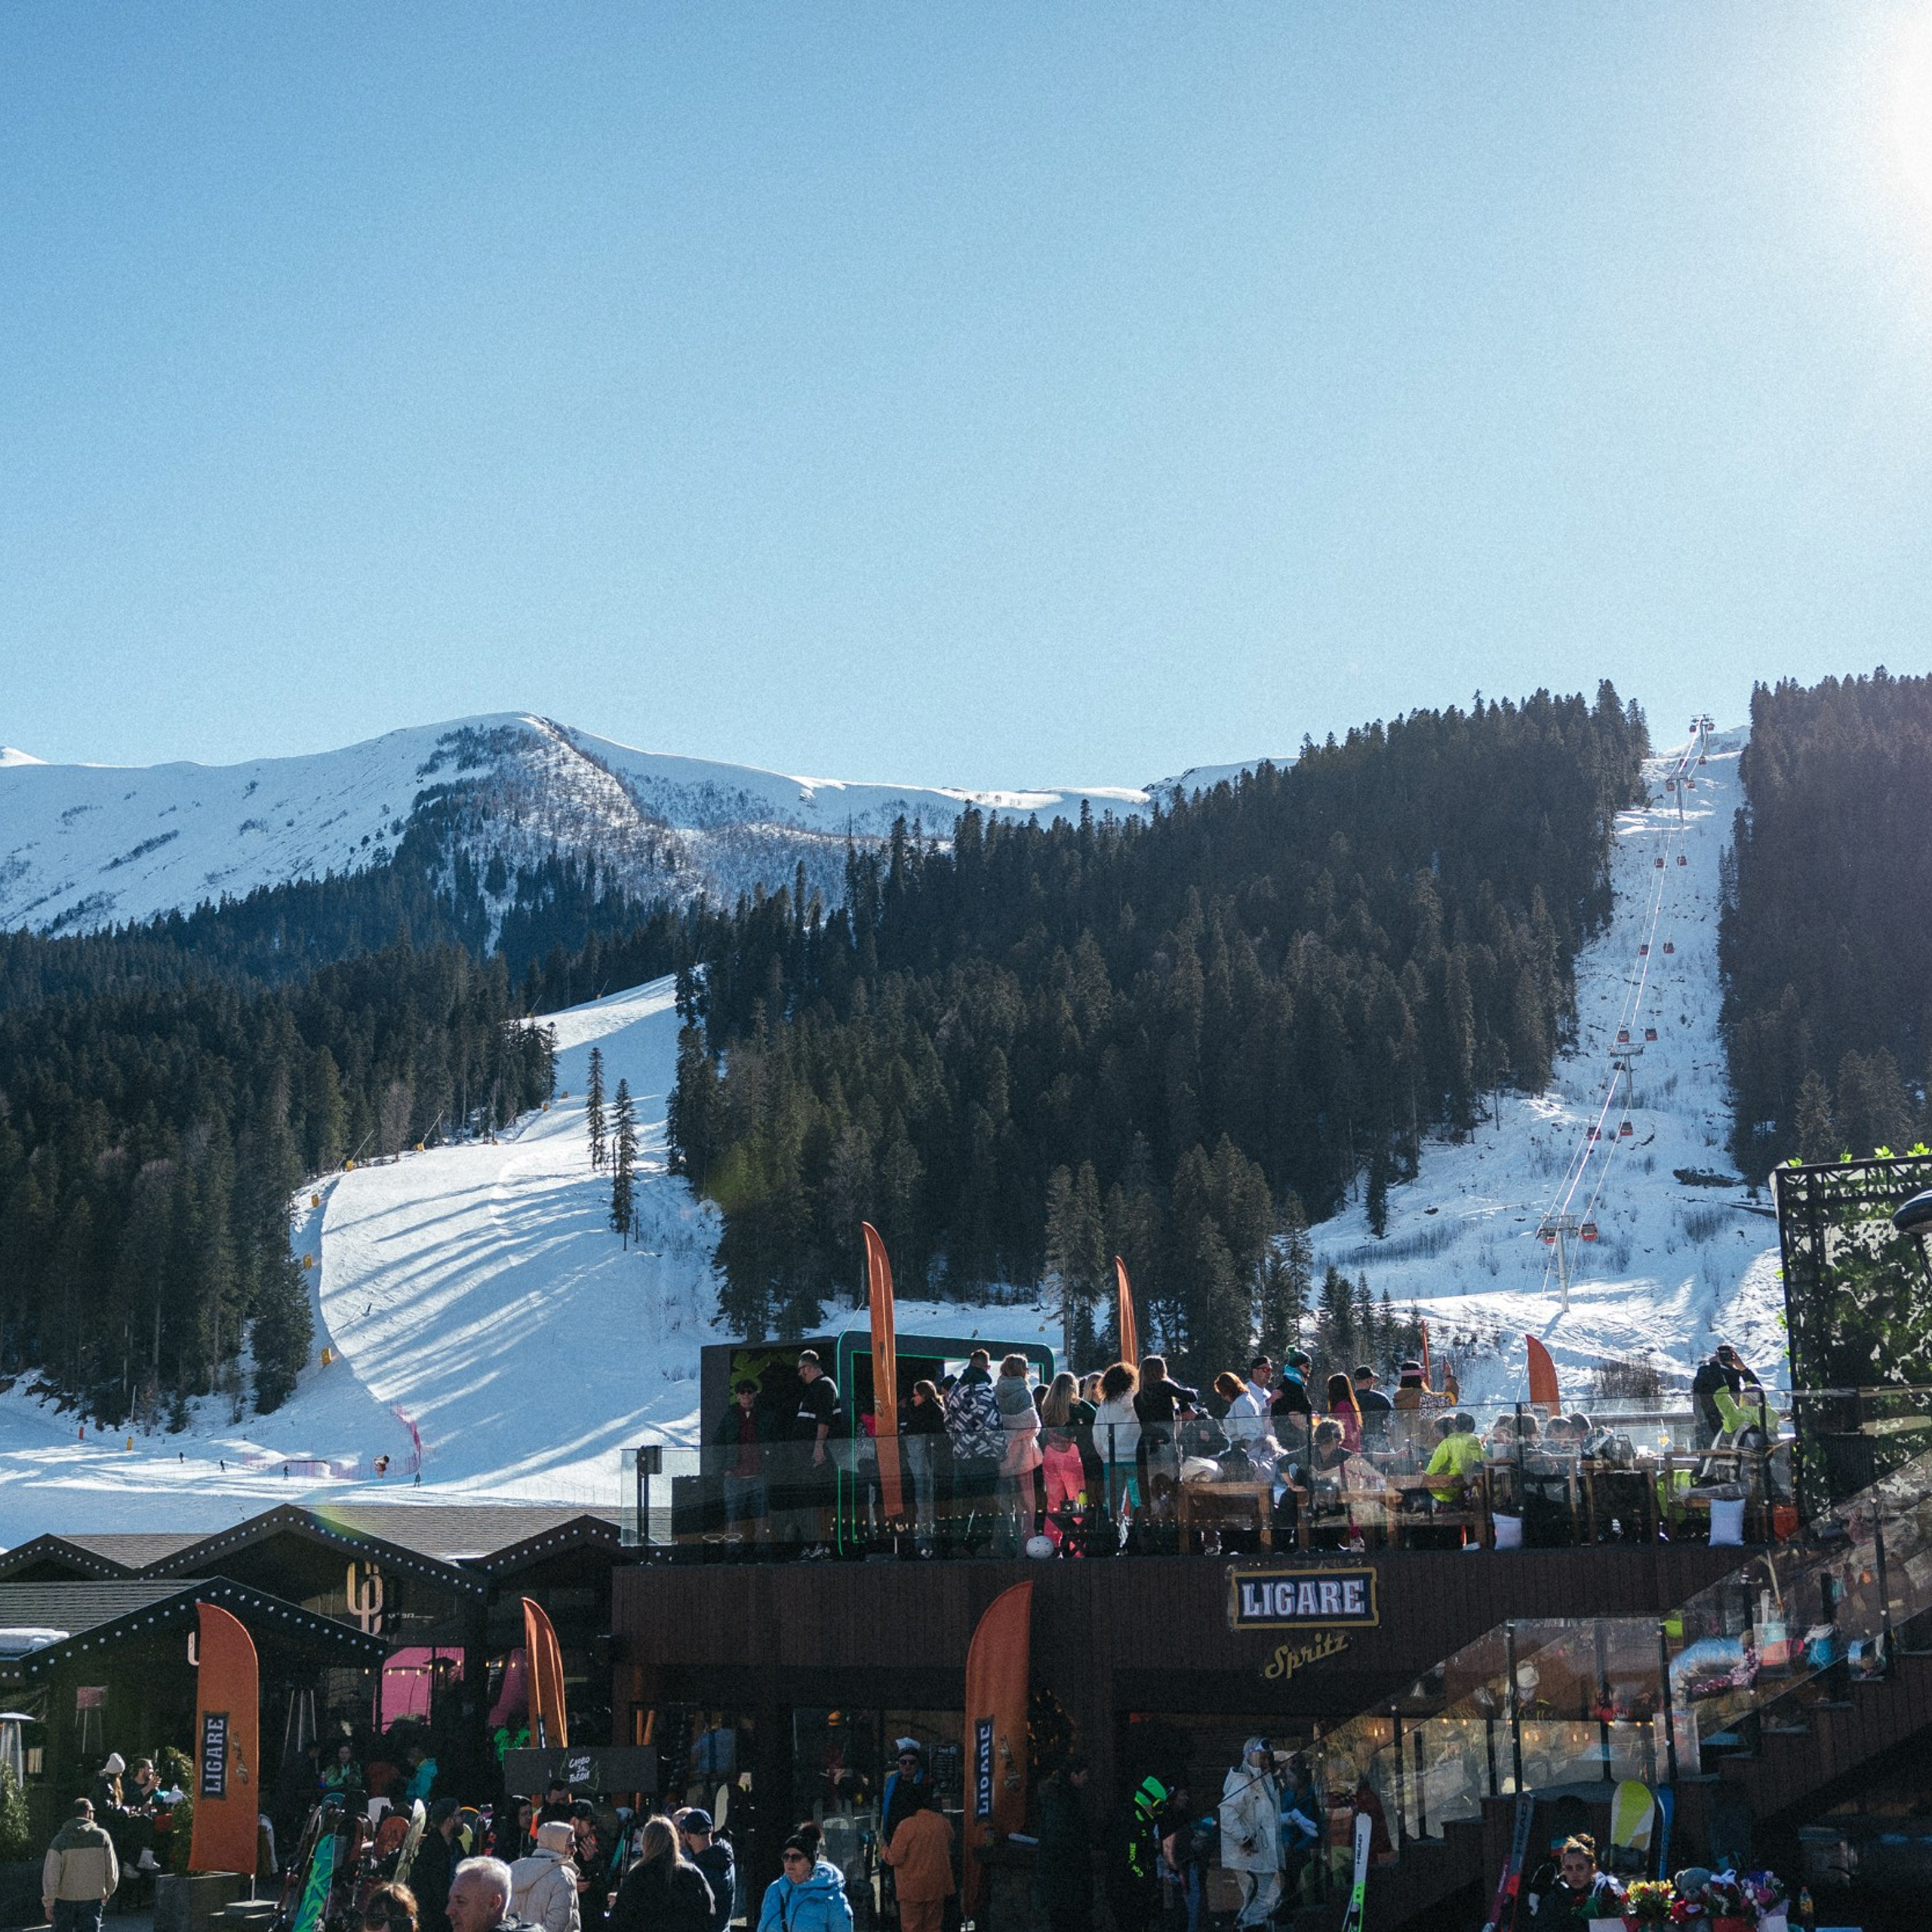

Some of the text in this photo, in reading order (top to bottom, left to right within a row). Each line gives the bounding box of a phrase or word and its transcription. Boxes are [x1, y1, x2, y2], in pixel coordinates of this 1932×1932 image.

[1241, 1580, 1366, 1617] LIGARE
[1264, 1632, 1349, 1679] Spritz
[205, 1718, 224, 1792] LIGARE
